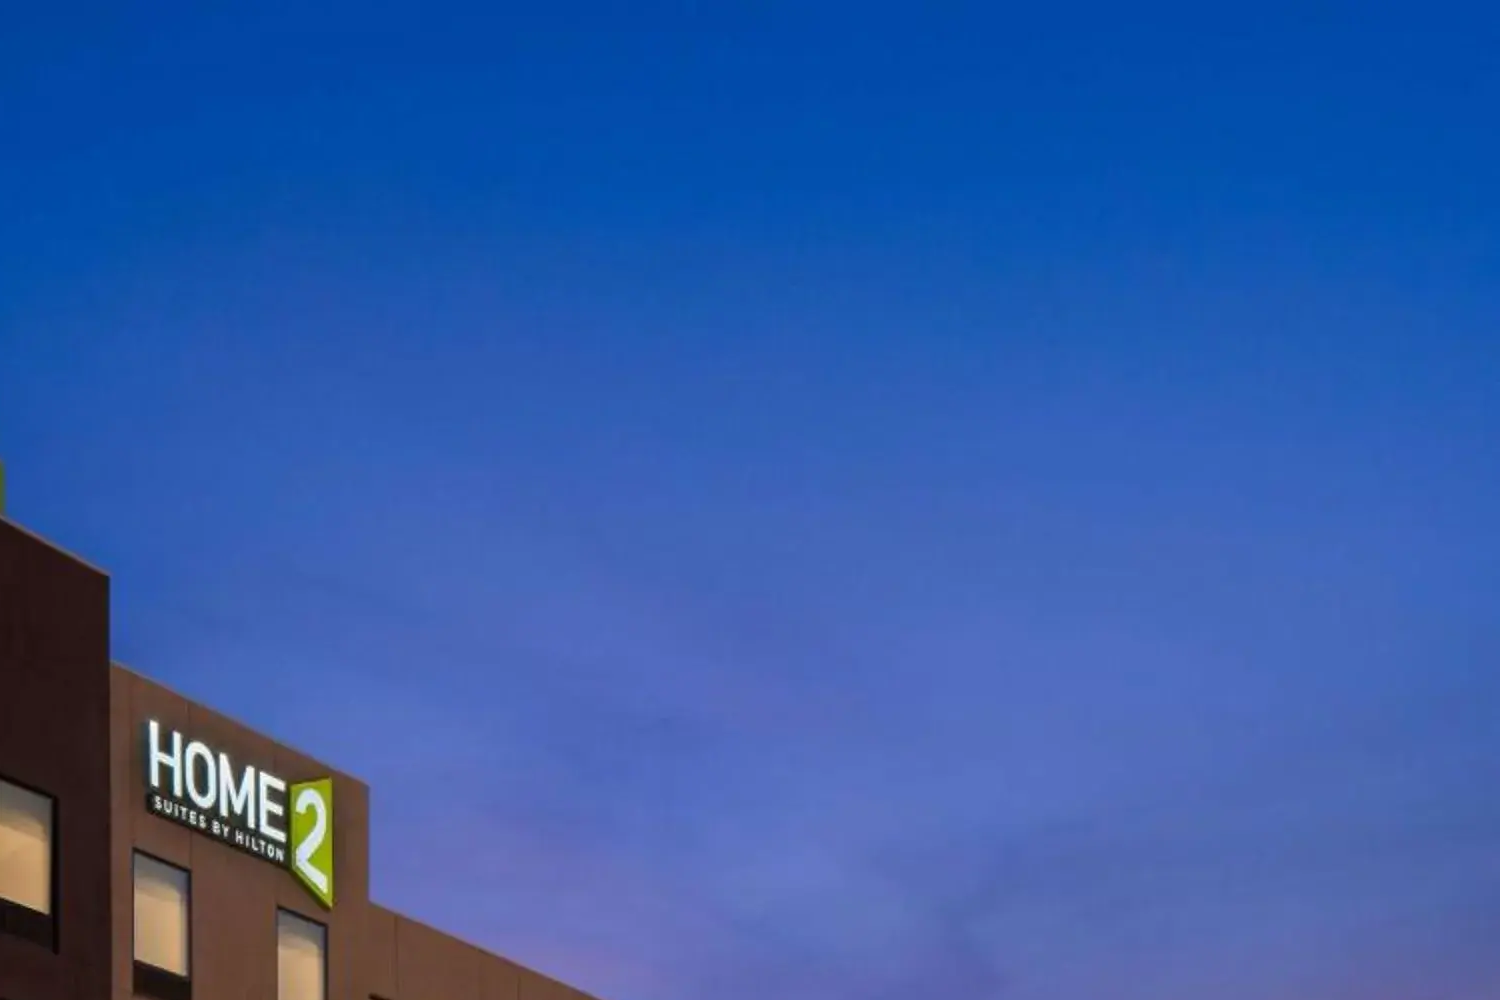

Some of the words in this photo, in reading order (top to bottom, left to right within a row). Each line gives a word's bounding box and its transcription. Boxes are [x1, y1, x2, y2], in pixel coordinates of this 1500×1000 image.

[149, 719, 286, 843] HOME
[295, 788, 328, 894] 2
[154, 796, 207, 830] SUITES
[212, 819, 230, 839] BY
[235, 831, 284, 863] HILTON
